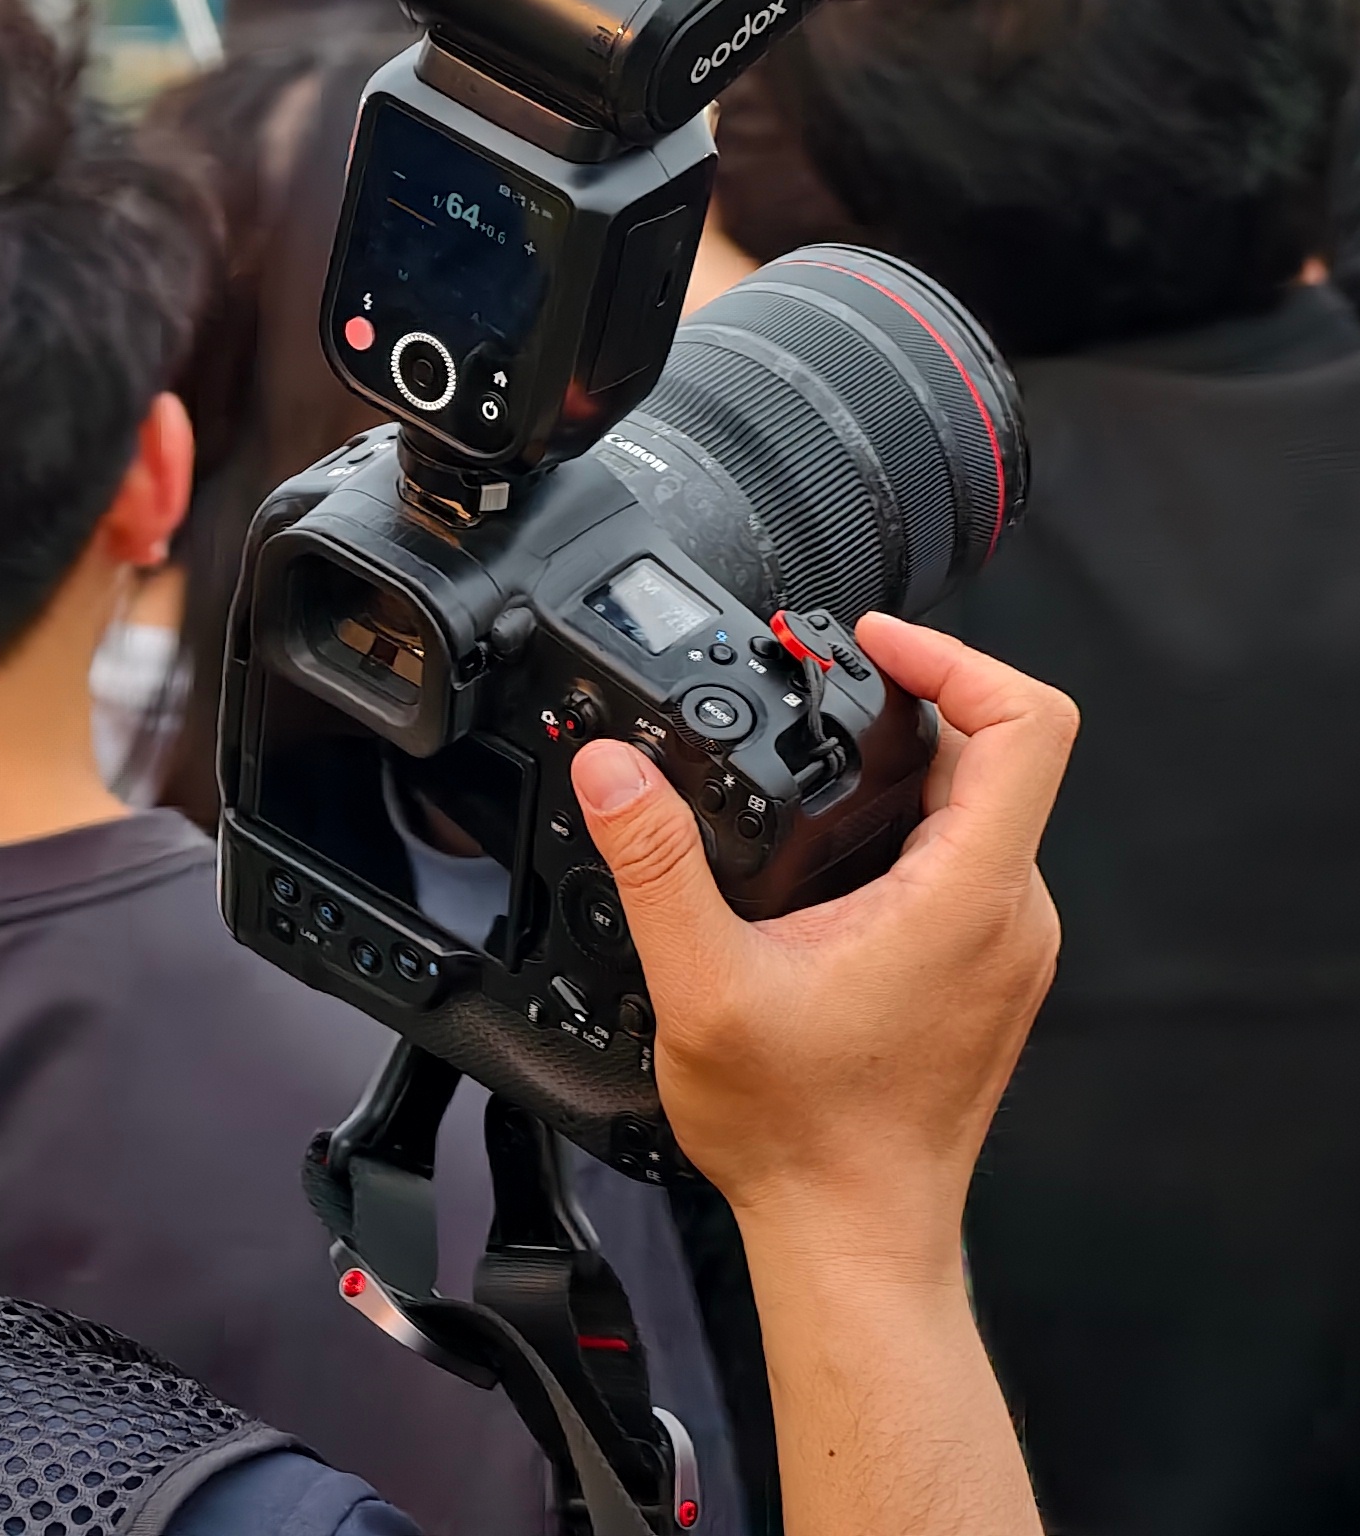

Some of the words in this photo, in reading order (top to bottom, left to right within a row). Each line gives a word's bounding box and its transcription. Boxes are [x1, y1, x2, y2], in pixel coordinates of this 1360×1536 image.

[603, 433, 669, 473] Canon
[747, 658, 768, 675] WB
[702, 702, 733, 724] MODE
[635, 717, 667, 739] AF-ON
[594, 912, 612, 927] SET
[560, 1021, 578, 1035] OFF
[594, 1025, 610, 1040] ON
[582, 1031, 606, 1050] LOCK
